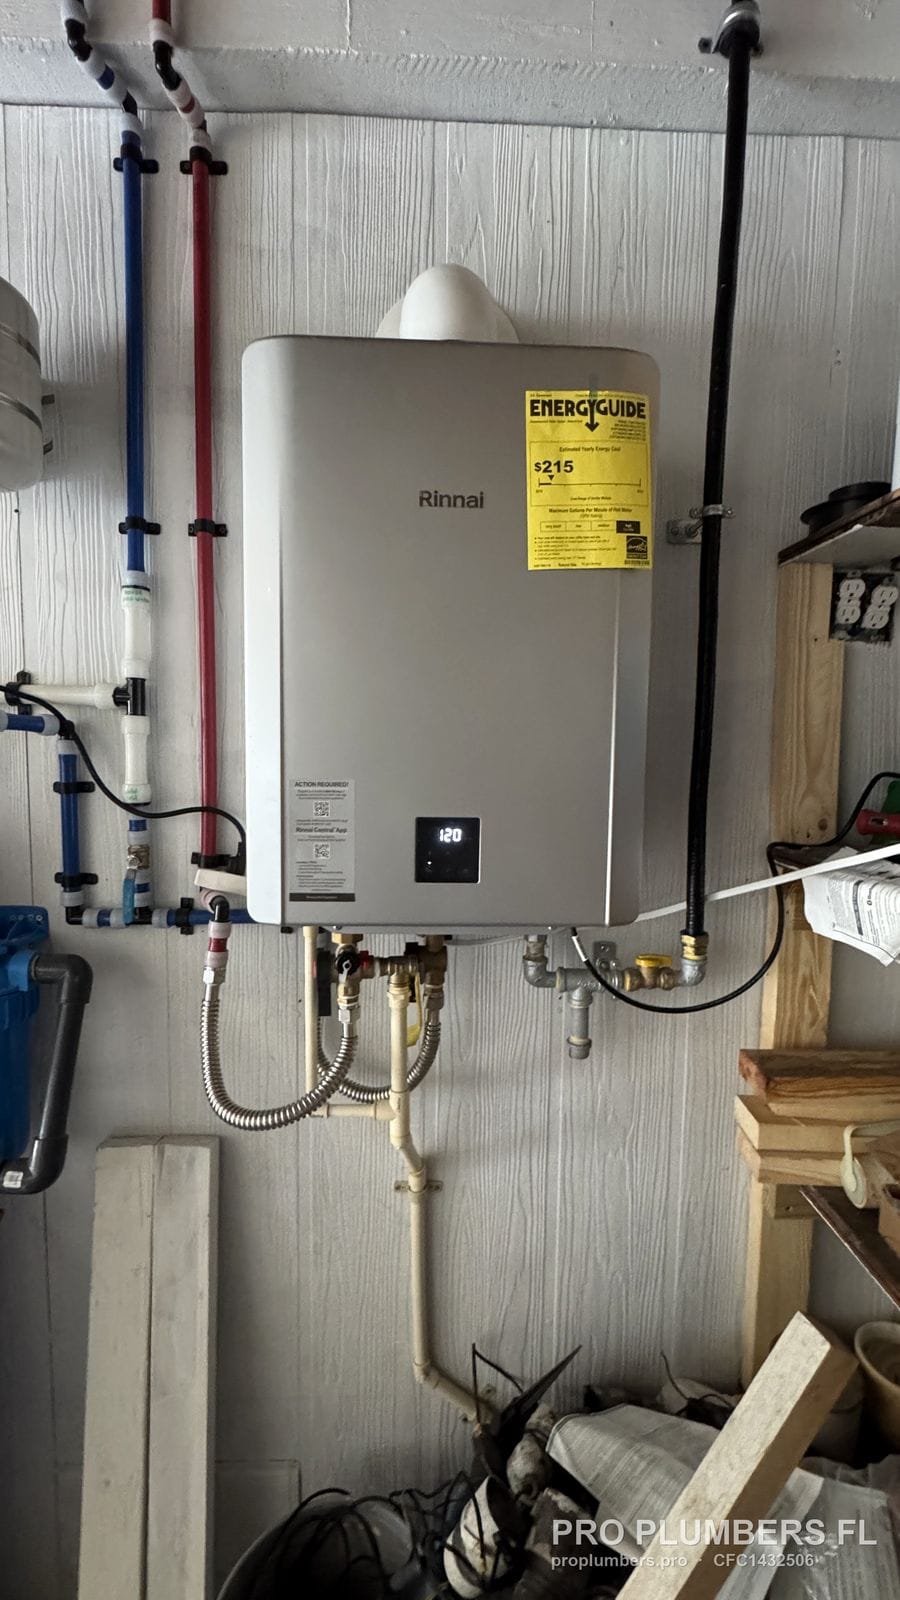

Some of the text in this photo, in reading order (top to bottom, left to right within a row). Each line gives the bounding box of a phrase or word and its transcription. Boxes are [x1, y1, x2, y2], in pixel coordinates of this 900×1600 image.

[530, 398, 646, 419] ENERGYGUIDE
[534, 460, 574, 473] $215
[419, 490, 484, 508] Rinnai
[439, 827, 463, 843] 120
